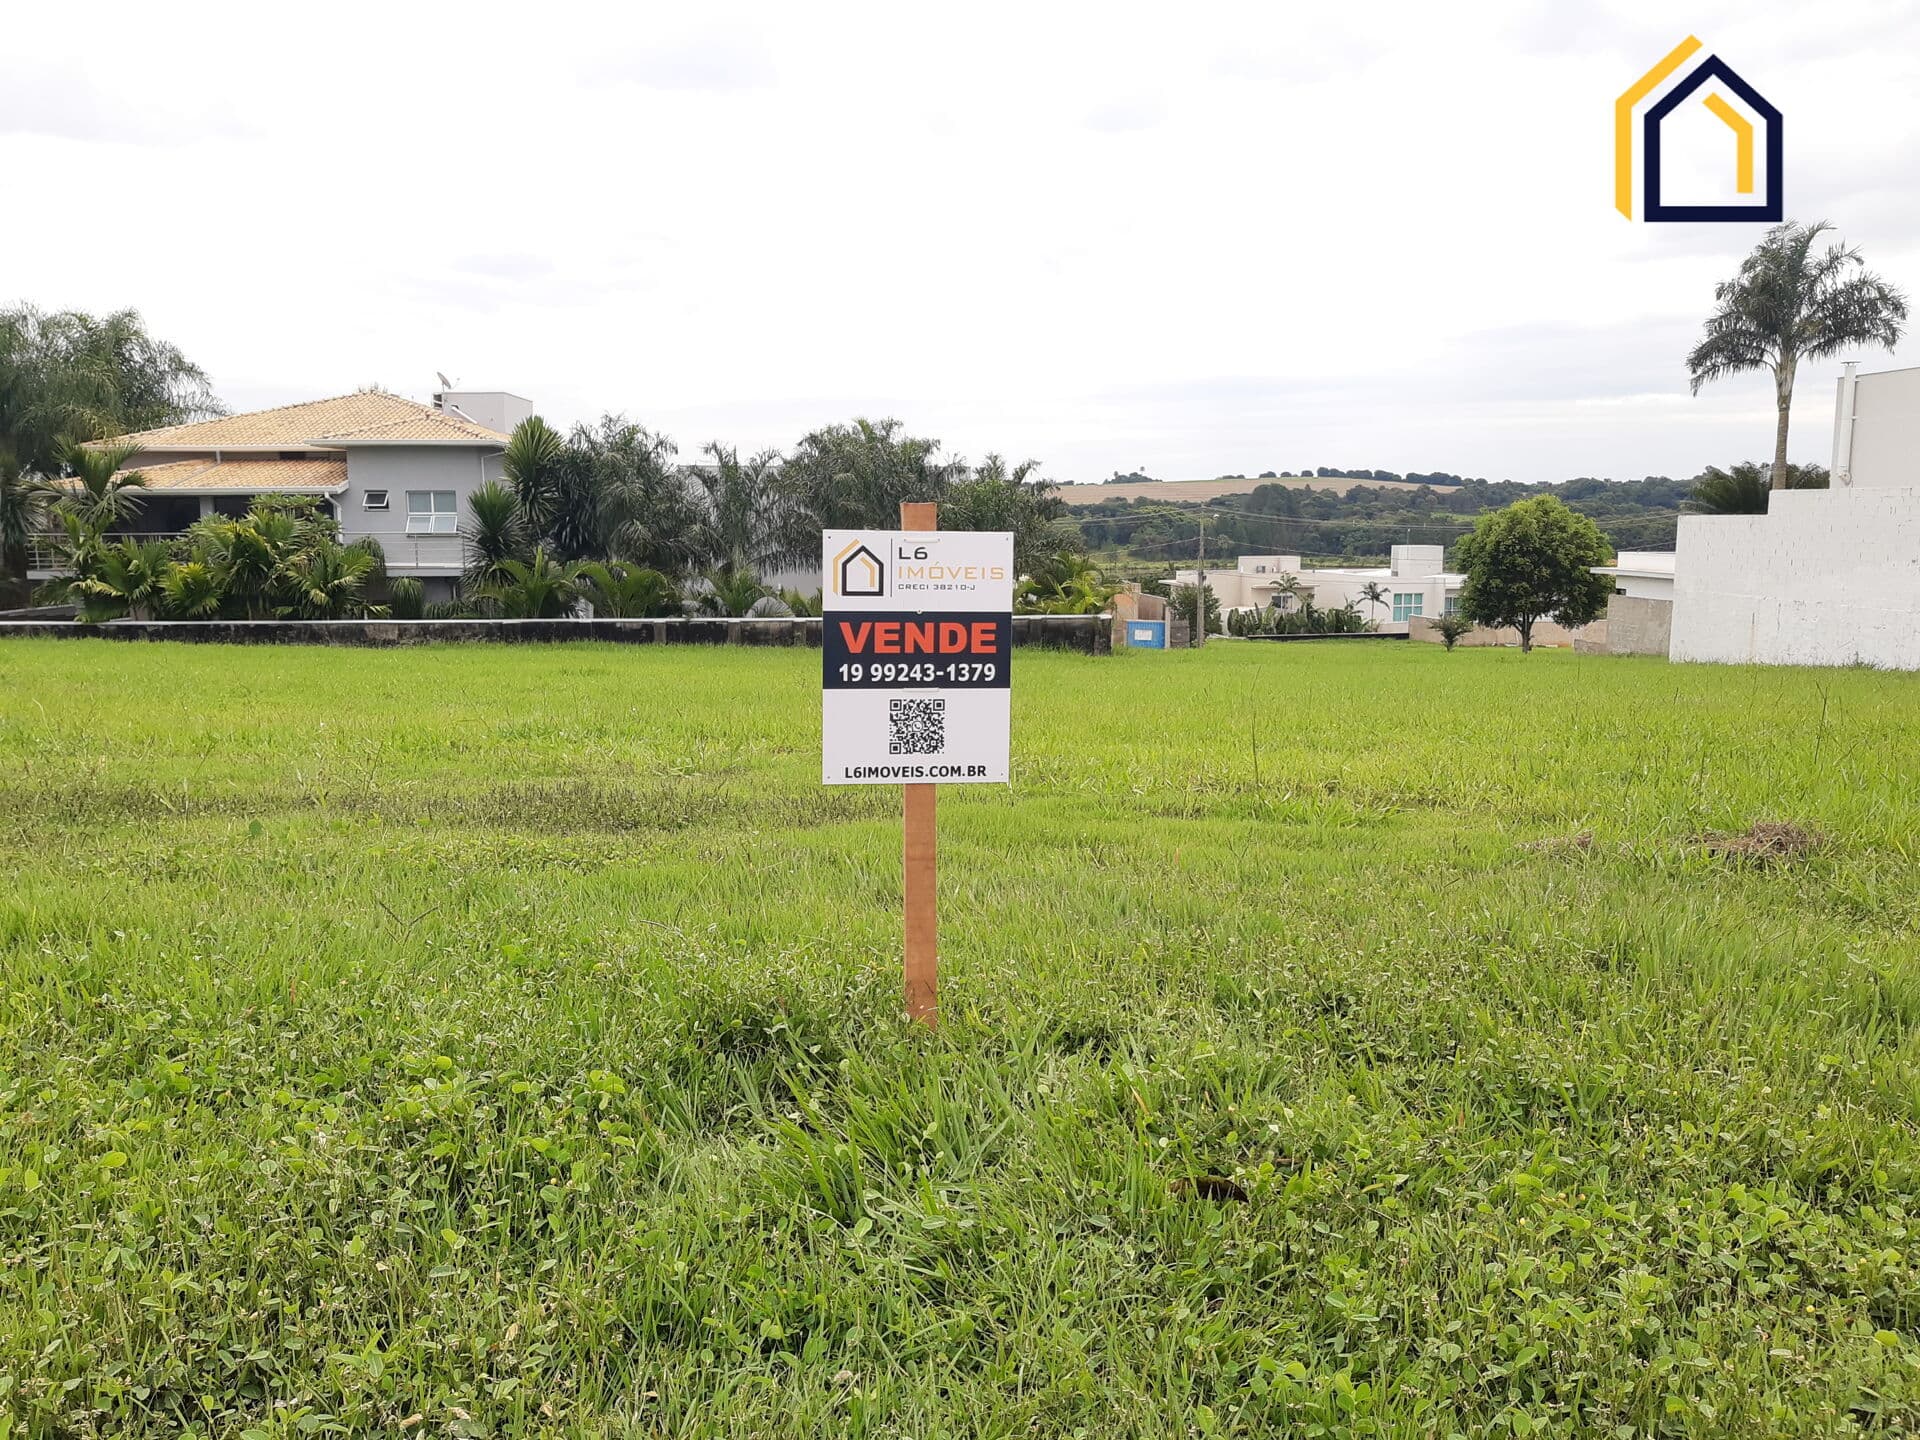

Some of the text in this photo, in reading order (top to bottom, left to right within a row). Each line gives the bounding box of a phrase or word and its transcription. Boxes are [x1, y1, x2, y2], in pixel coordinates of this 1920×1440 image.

[898, 546, 929, 560] L6
[898, 562, 1004, 580] IMÓVEIS
[933, 583, 976, 591] 38210-J
[839, 622, 997, 654] VENDE
[839, 663, 996, 682] 19 99243-1379
[844, 765, 987, 779] L6IMOVEIS.COM.BR
